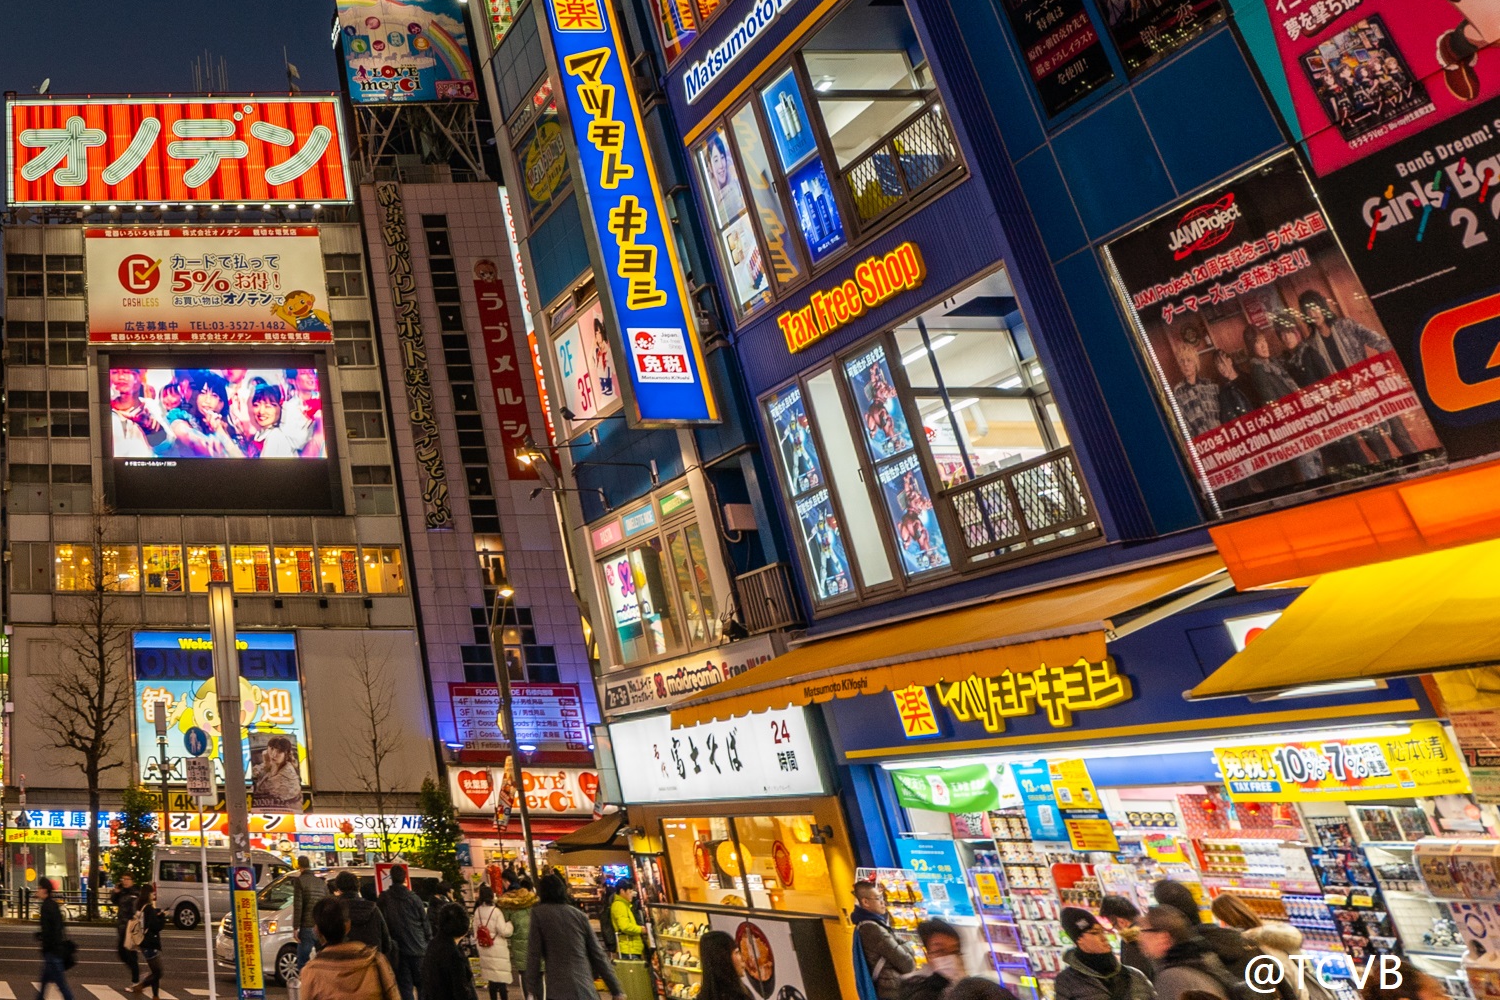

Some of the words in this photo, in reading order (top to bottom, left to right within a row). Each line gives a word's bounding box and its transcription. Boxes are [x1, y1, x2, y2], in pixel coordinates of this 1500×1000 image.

[371, 65, 420, 79] LOVE
[19, 104, 332, 188] オノデン
[1395, 150, 1436, 178] BanG
[1434, 123, 1494, 161] Dream!
[565, 47, 667, 310] マツモトキヨシ
[170, 254, 281, 271] カードで払って
[171, 270, 231, 293] 5%
[1133, 288, 1157, 311] JAM
[1156, 275, 1195, 302] Project
[122, 297, 160, 308] CASHLESS
[777, 308, 816, 352] Tax
[813, 283, 862, 330] Free
[855, 241, 920, 301] Shop
[124, 320, 179, 332] 広告募集中
[189, 320, 287, 331] TEL:03-3527-1482
[559, 339, 574, 379] 2F
[641, 355, 683, 374] 免税
[576, 368, 593, 412] 3F
[803, 683, 841, 700] Matsumoto
[259, 688, 295, 723] 迎
[770, 718, 791, 745] 24
[777, 749, 799, 773] 時間
[1386, 735, 1449, 763] 松本清
[1232, 782, 1251, 793] TAX
[1250, 781, 1274, 792] FREE
